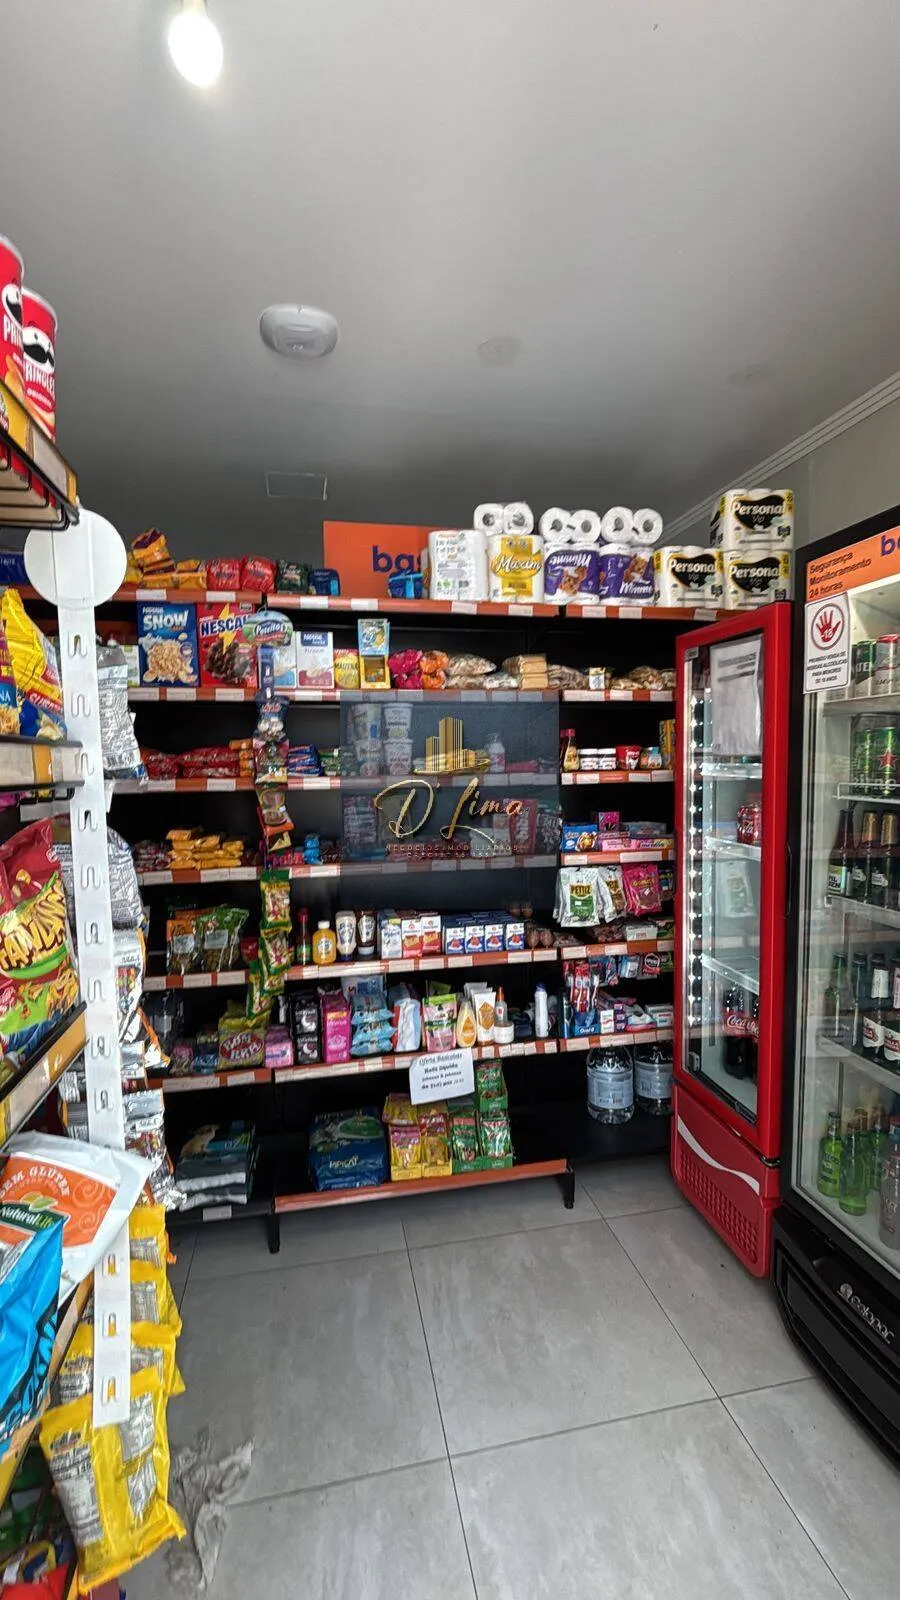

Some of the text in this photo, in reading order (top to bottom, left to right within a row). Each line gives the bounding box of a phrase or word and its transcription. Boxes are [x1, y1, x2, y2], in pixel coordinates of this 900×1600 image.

[731, 501, 785, 516] Personal
[880, 534, 900, 557] b
[372, 545, 421, 573] ba
[668, 559, 716, 573] Personal
[728, 564, 780, 579] Personal
[809, 558, 872, 586] Monitoramento
[809, 581, 843, 599] 24 horas
[143, 610, 188, 632] SNOW
